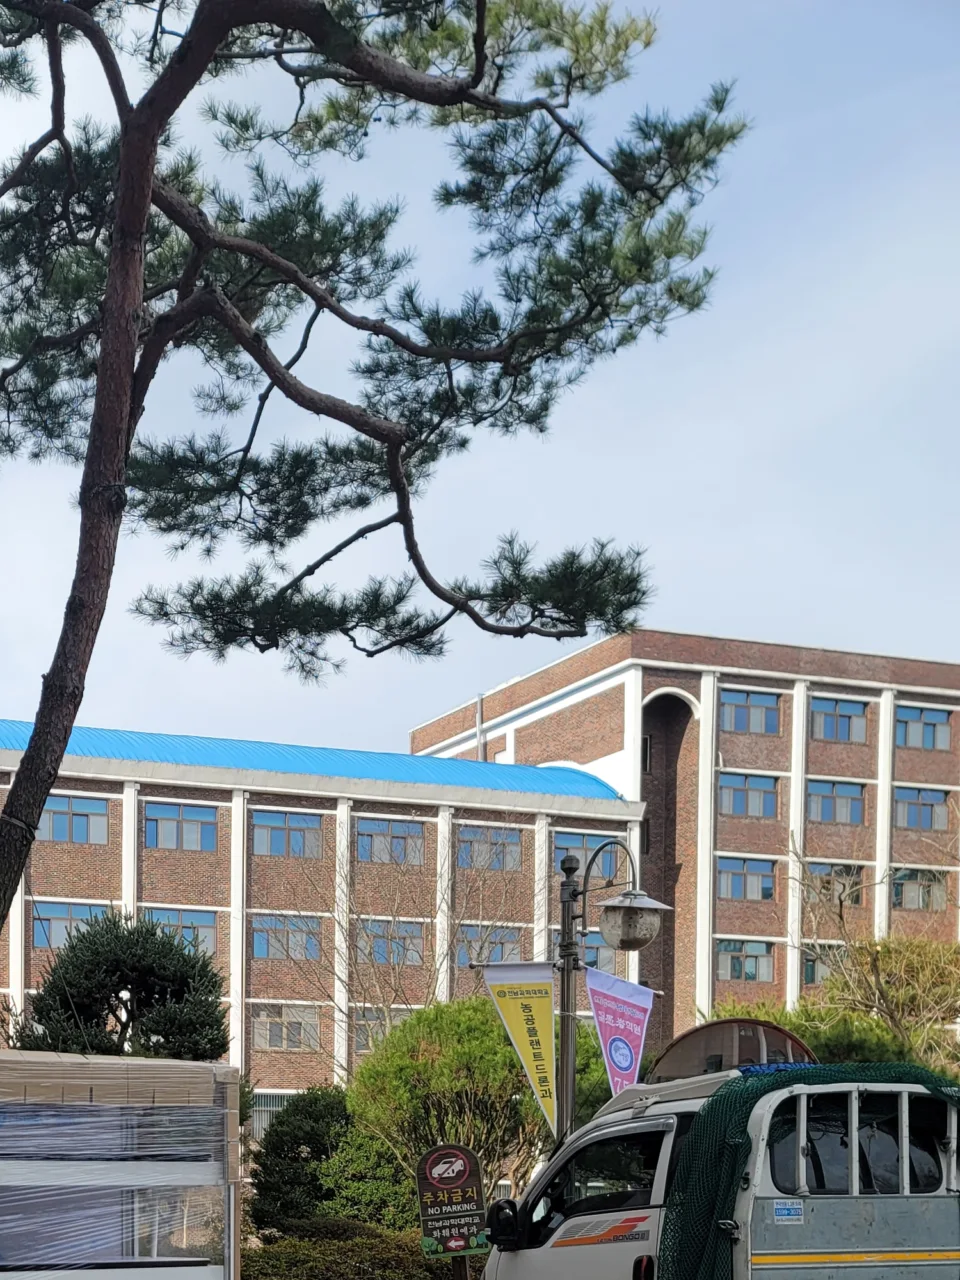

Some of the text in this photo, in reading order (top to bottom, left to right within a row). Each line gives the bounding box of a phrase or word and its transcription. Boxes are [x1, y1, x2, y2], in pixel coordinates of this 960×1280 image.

[520, 1002, 553, 1099] 농공플랜트드론과
[423, 1187, 477, 1205] 주차금지
[428, 1202, 477, 1215] NO PARKING
[427, 1216, 480, 1228] 전남과학대학교
[432, 1225, 478, 1238] 화훼원예과
[613, 1232, 640, 1242] BONGO
